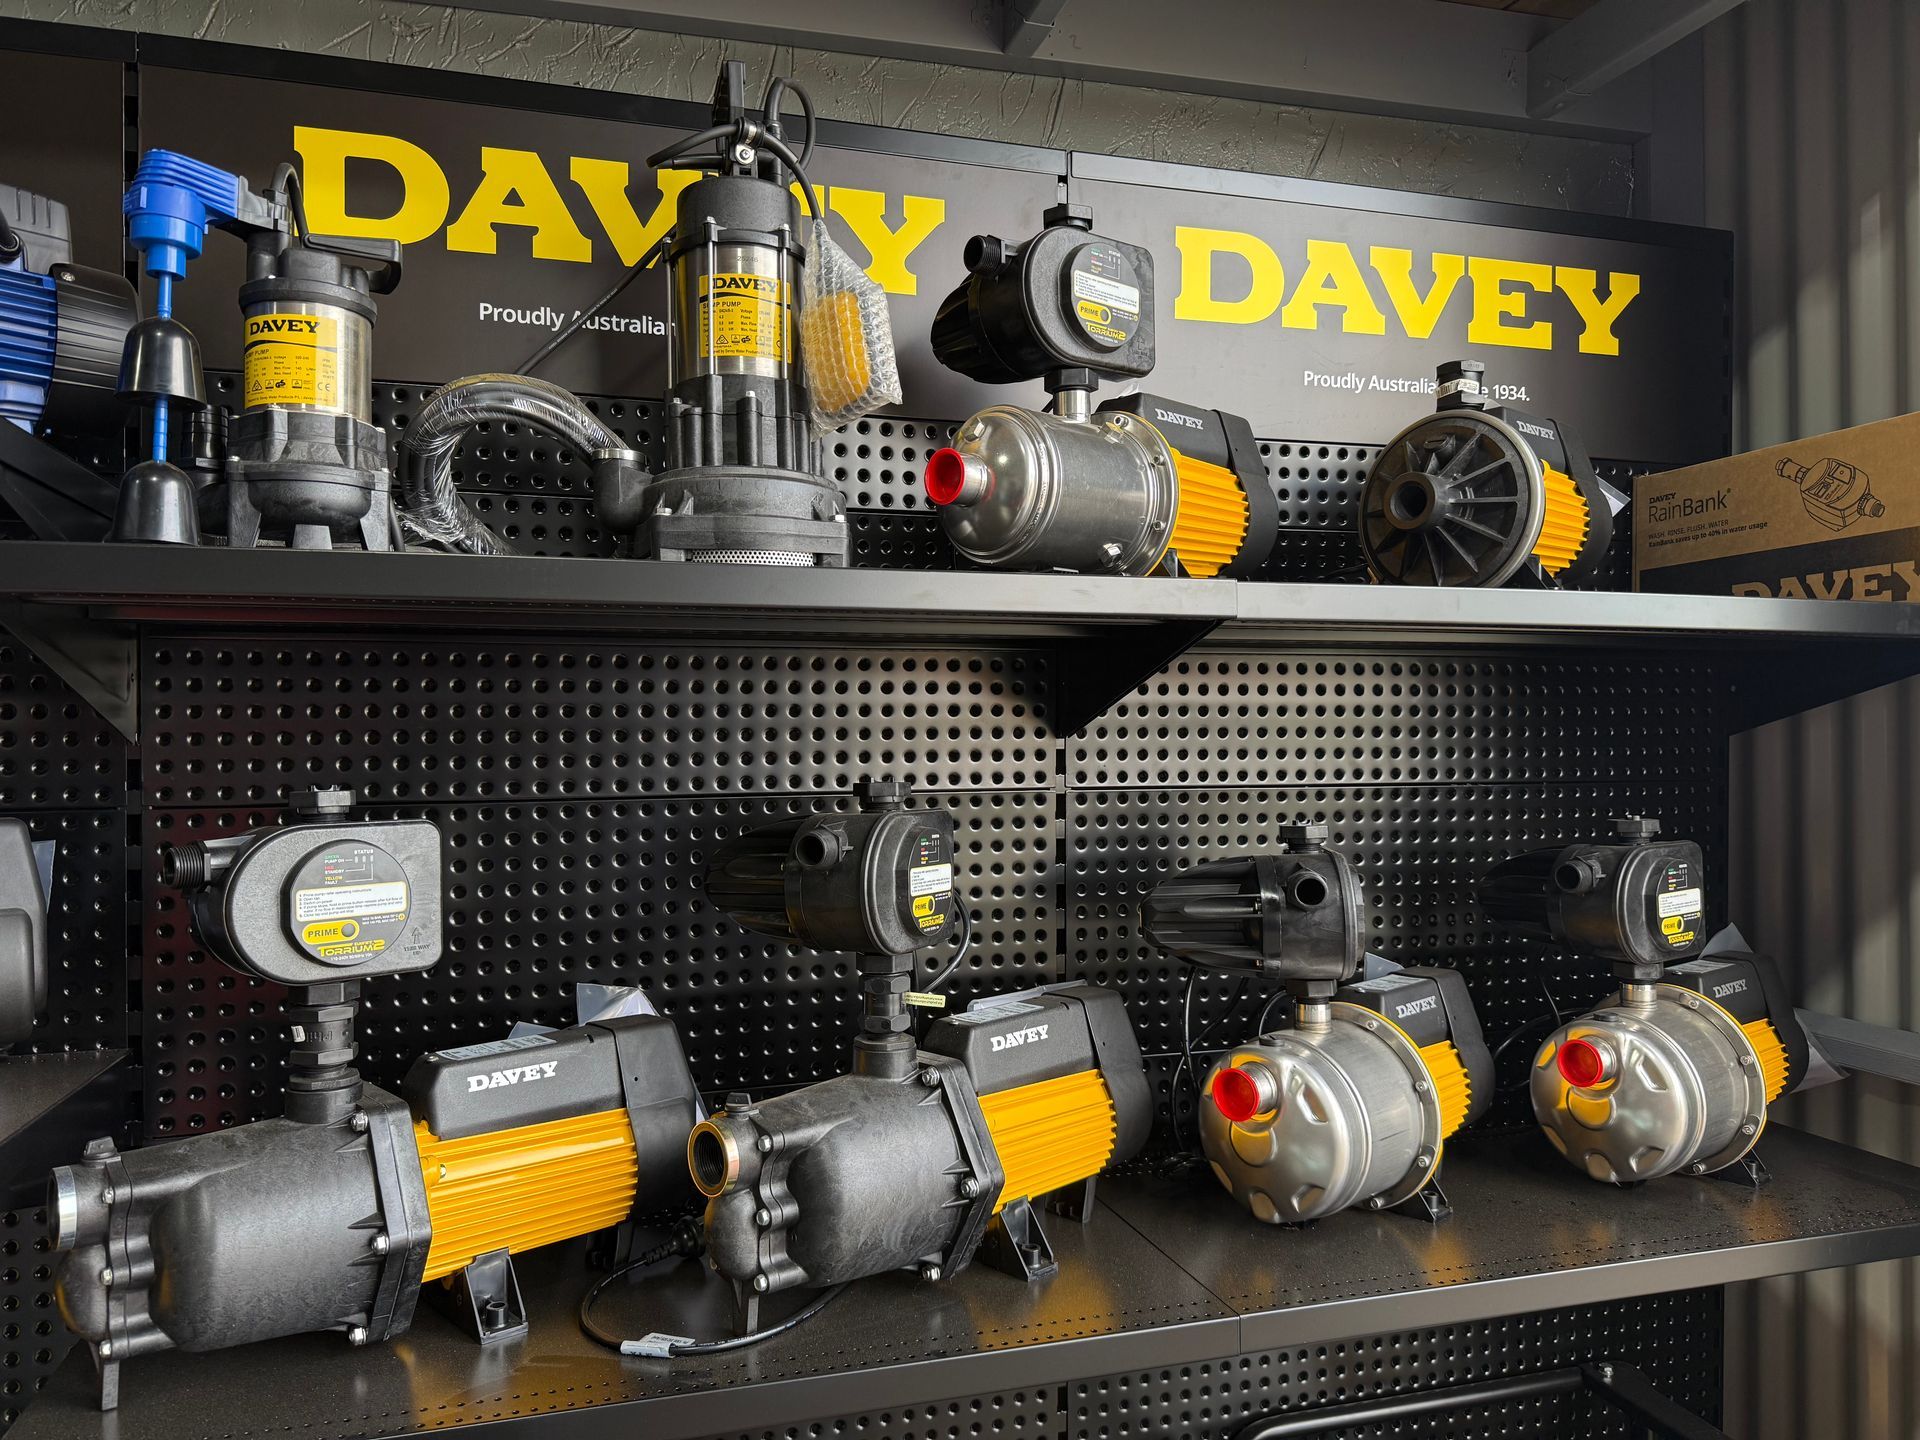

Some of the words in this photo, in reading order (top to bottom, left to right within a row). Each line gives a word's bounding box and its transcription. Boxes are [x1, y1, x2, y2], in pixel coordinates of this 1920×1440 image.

[293, 126, 945, 296] DAVY
[712, 277, 777, 293] DAVEY
[1175, 225, 1640, 356] DAVEY
[479, 303, 565, 331] Proudly
[1080, 305, 1099, 317] PRIME
[250, 319, 320, 336] DAVEY
[1304, 371, 1366, 394] Proudly
[1368, 375, 1437, 396] Australia
[1493, 384, 1530, 402] 1934.
[1154, 408, 1204, 430] DAVEY
[1516, 420, 1555, 440] DAVEY
[1649, 492, 1676, 504] DAVEY
[1649, 490, 1728, 523] RainBank
[1675, 535, 1691, 543] saves
[1729, 525, 1747, 534] water
[1748, 522, 1768, 530] usage
[1708, 519, 1729, 529] WATER
[308, 927, 339, 938] PRIME
[317, 939, 385, 957] TORRIUM2
[1713, 979, 1748, 998] DAVEY
[1396, 995, 1438, 1018] DAVEY
[990, 1024, 1049, 1052] DAVEY
[467, 1061, 558, 1092] DAVEY
